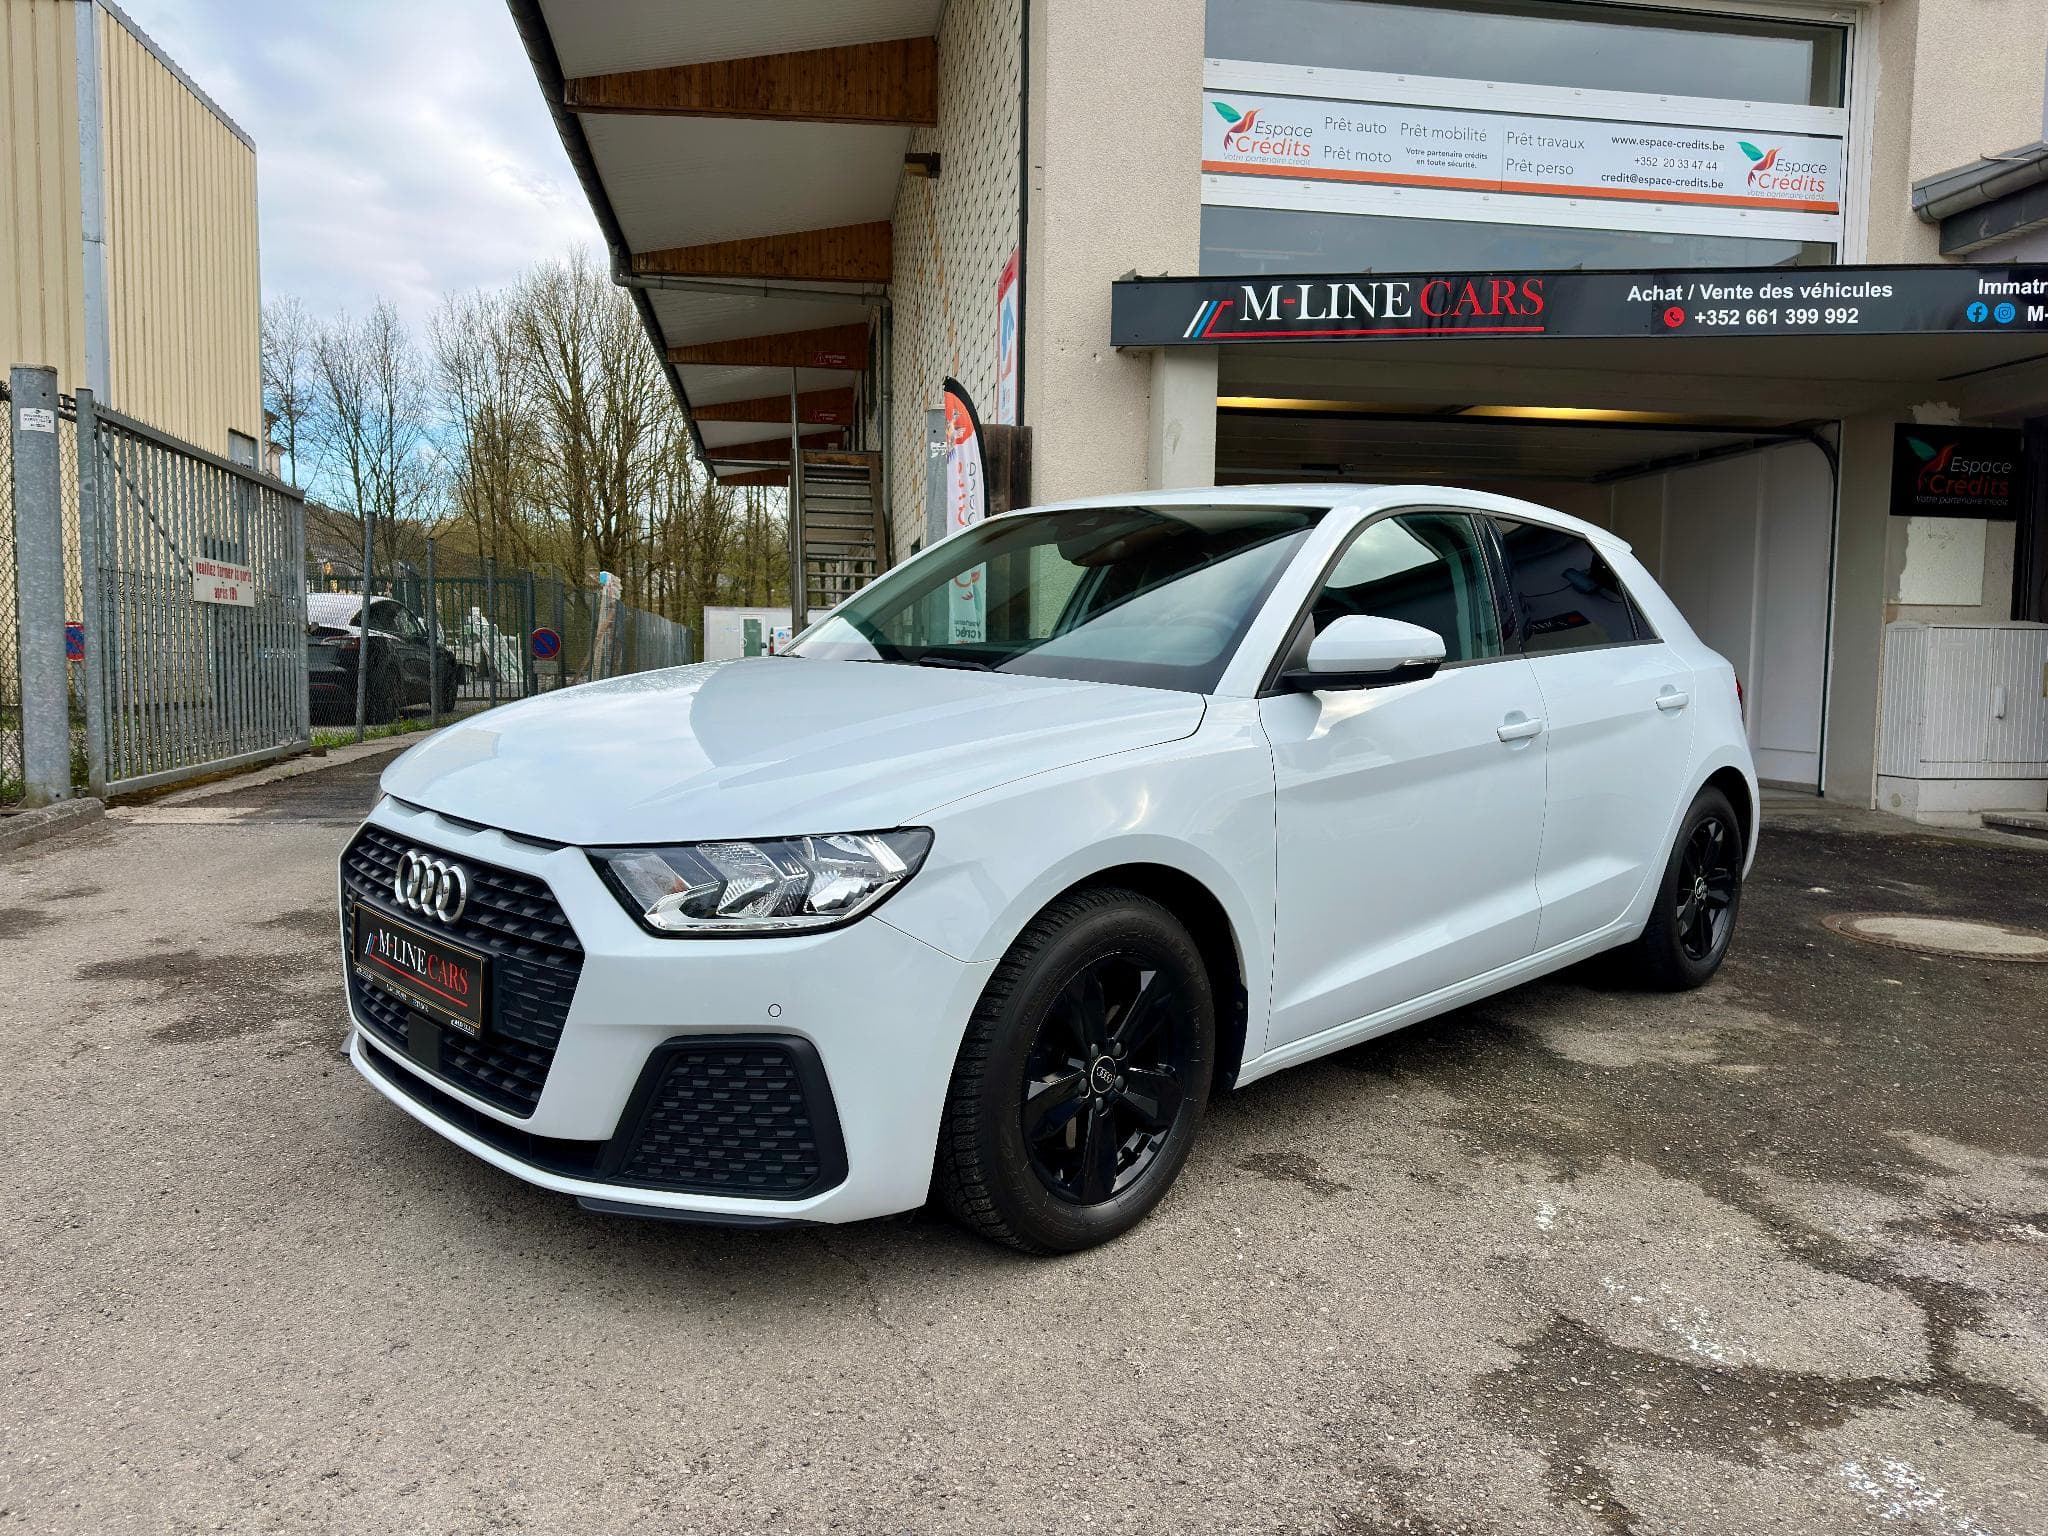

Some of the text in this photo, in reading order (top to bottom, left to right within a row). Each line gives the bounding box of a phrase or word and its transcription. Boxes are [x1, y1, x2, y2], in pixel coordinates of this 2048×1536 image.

[1254, 120, 1313, 138] Espace
[1324, 116, 1387, 134] Prêt auto
[1400, 122, 1487, 142] Prêt mobilité
[1236, 136, 1312, 157] Crédits
[1506, 131, 1585, 149] Prêt travaux
[1611, 135, 1725, 151] www.espace-credits.be
[1324, 145, 1392, 163] Prêt moto
[1406, 147, 1488, 161] Votre partenaire crédits
[1426, 158, 1446, 167] toute
[1506, 157, 1574, 176] Prêt perso
[1634, 156, 1718, 171] +352 20 33 47 44
[1775, 158, 1828, 174] Espace
[1601, 172, 1724, 189] credit@espace-credits.be
[1758, 173, 1825, 192] Crédits
[1239, 278, 1545, 321] M-LINE CARS
[1626, 281, 1893, 302] Achat / Vente des véhicules
[1694, 307, 1859, 326] +352 661 399 992
[1950, 456, 2012, 477] Espace
[1929, 474, 2009, 497] Crédits
[378, 928, 468, 995] M-LINE CARS
